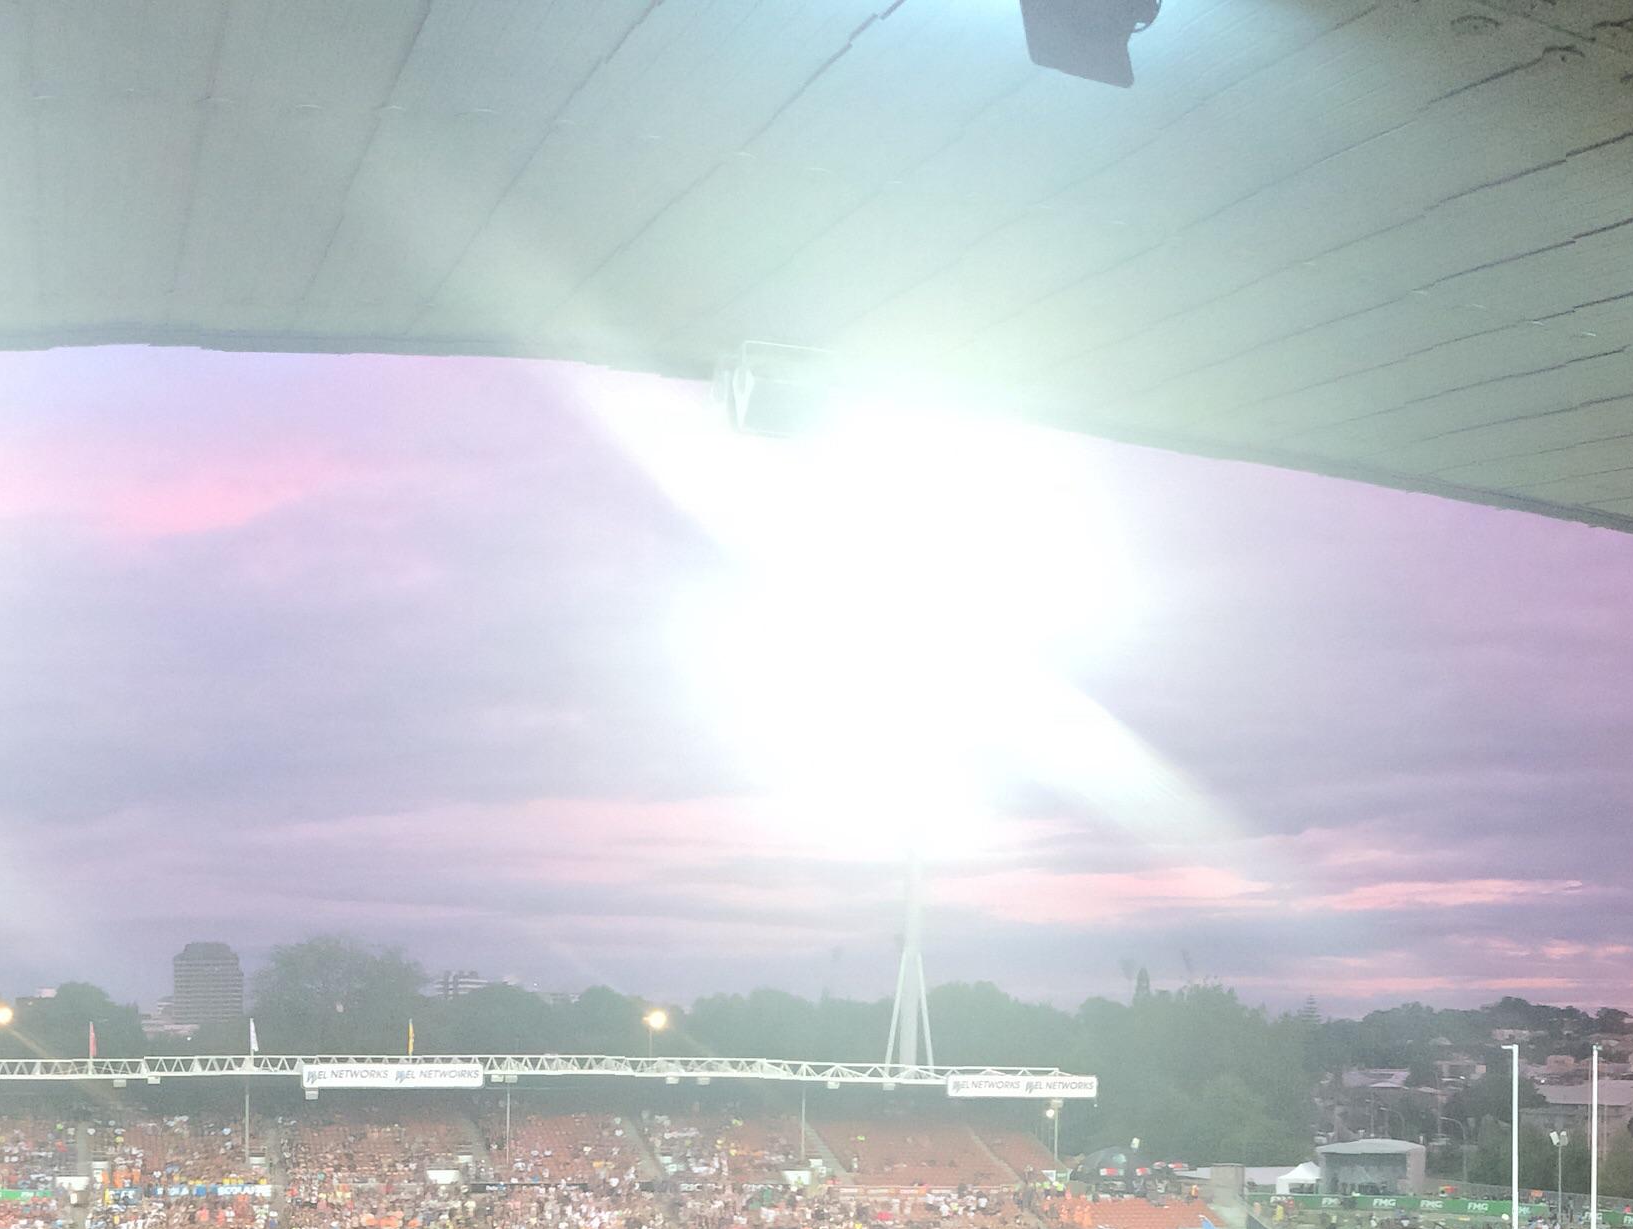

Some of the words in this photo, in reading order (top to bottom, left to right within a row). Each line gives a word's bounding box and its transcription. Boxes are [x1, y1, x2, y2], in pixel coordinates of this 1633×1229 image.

[330, 1069, 388, 1079] NETWORKS
[419, 1069, 480, 1079] NETWORKS
[971, 1080, 1021, 1089] NETWORKS
[1045, 1081, 1094, 1090] NETWORKS
[1373, 1198, 1396, 1207] FMG
[1420, 1199, 1444, 1208] FMG
[1467, 1202, 1488, 1211] FMG
